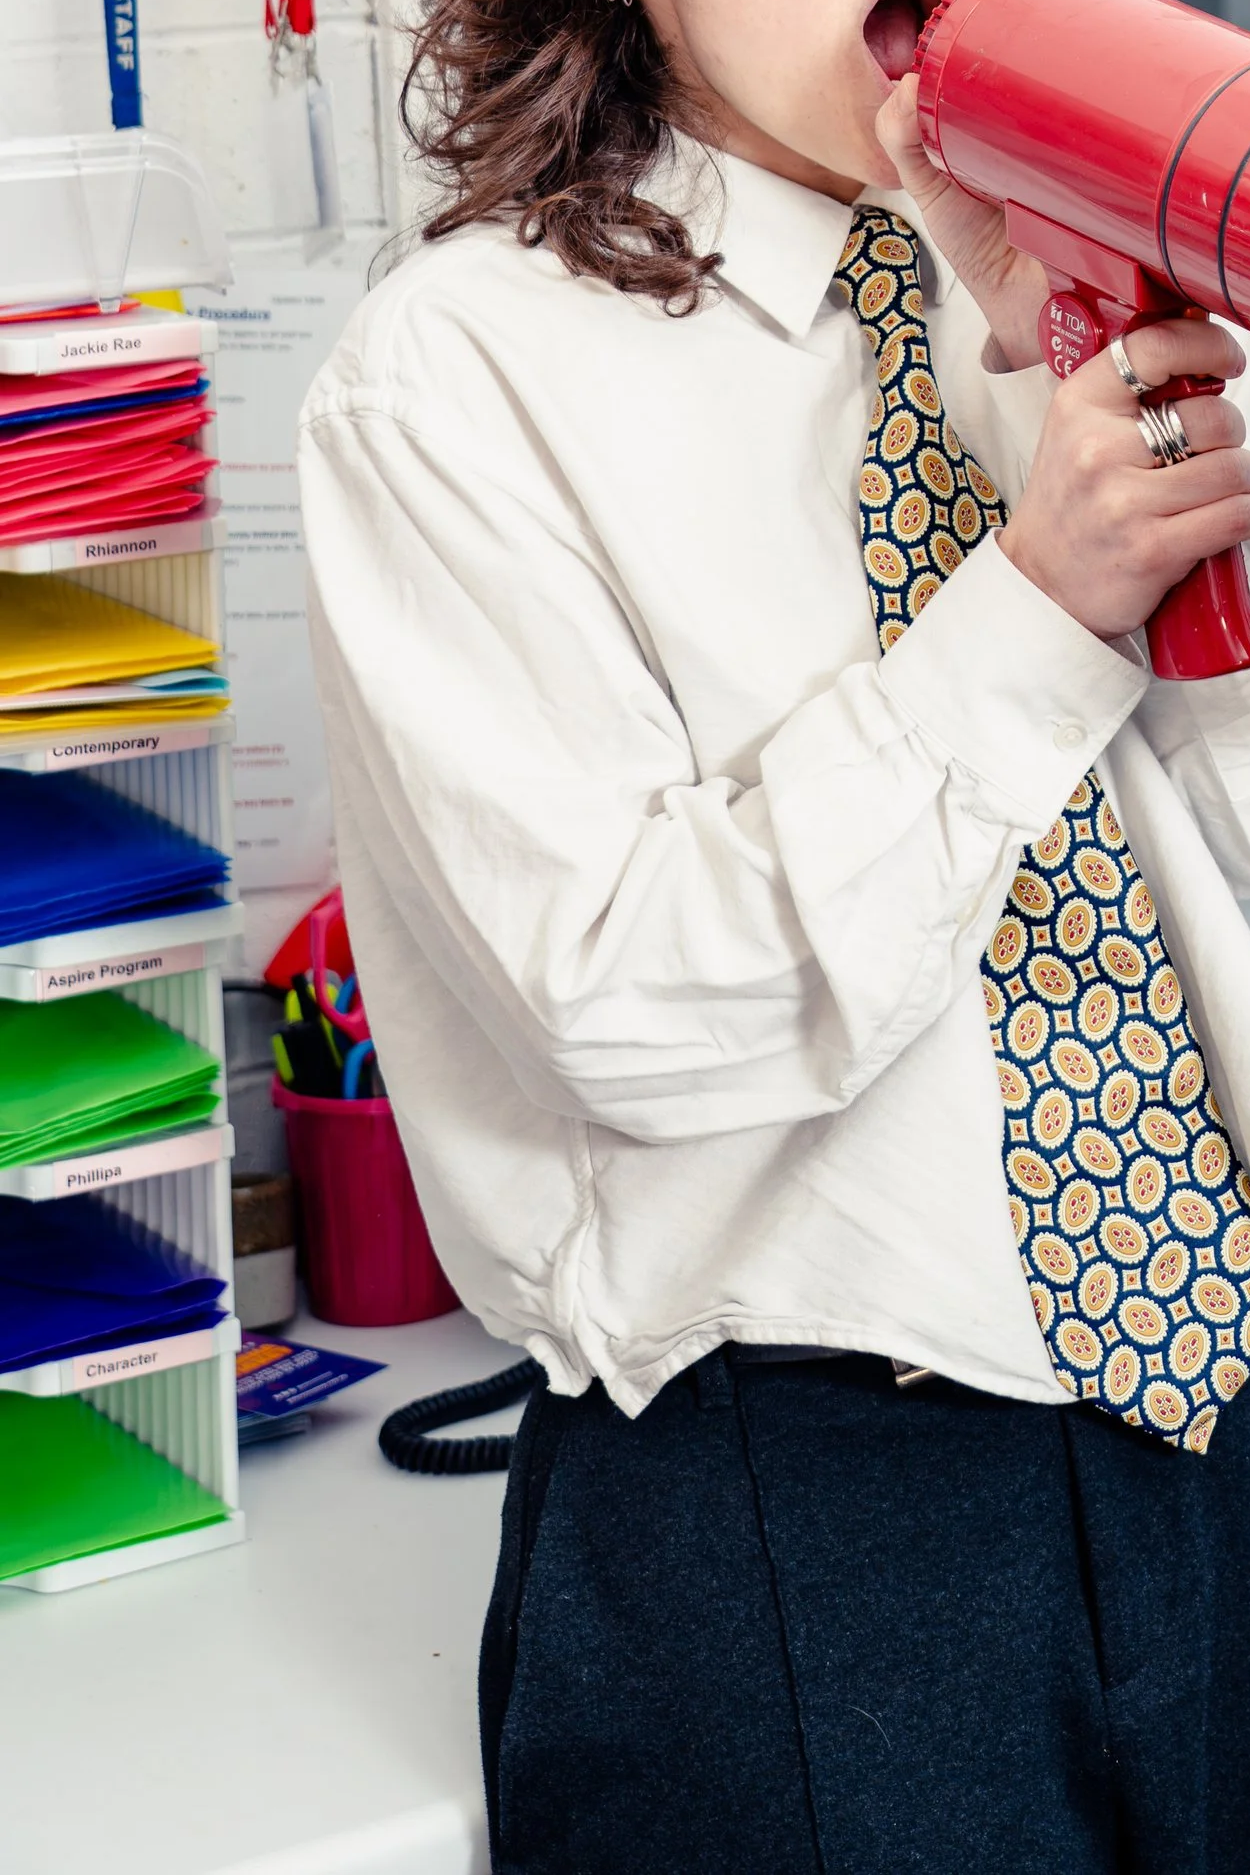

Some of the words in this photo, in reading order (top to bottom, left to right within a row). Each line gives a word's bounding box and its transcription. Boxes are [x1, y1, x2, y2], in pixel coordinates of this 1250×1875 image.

[198, 306, 271, 321] Procedure
[1065, 312, 1086, 335] TOA
[61, 340, 108, 357] Jackie
[113, 337, 142, 351] Rae
[1066, 344, 1080, 359] N29
[86, 538, 157, 558] Rhiannon
[53, 736, 160, 757] Contemporary
[47, 969, 96, 989] Aspire
[100, 956, 163, 979] Program
[67, 1166, 122, 1187] Phillipa
[86, 1352, 158, 1377] Character
